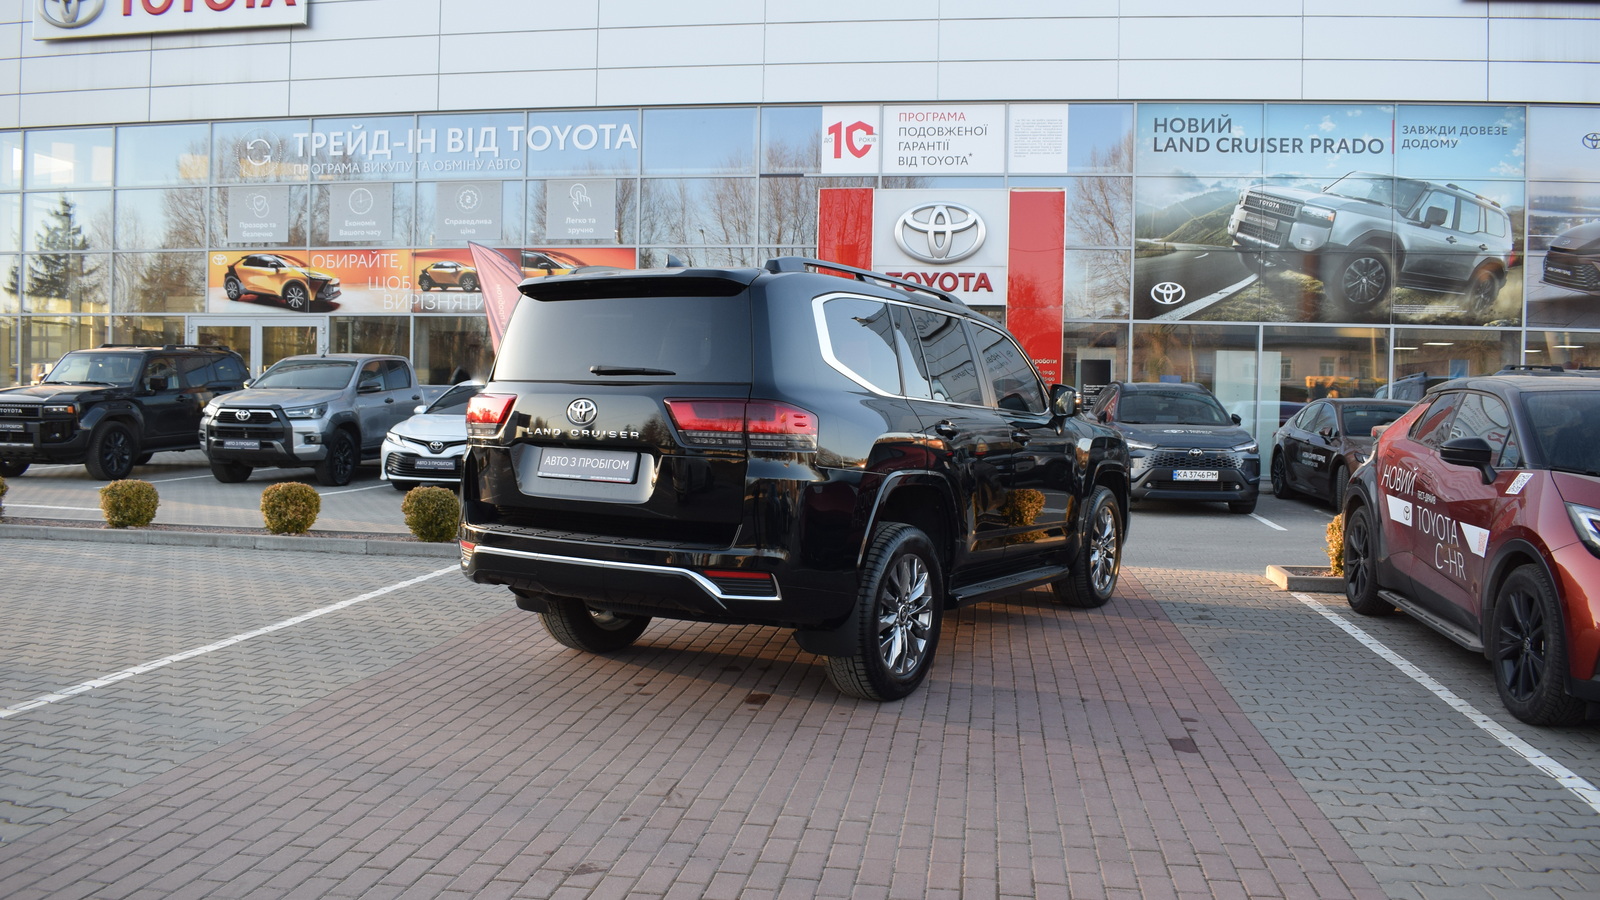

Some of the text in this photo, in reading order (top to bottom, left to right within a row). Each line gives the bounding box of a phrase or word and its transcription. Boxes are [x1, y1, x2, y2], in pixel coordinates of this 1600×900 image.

[898, 112, 966, 122] ПРОГРАМА
[1153, 114, 1232, 134] НОВИЙ
[898, 124, 989, 138] ПОДОВЖЕНОЇ
[1402, 125, 1508, 136] ЗАВЖДИ ДОВЕЗЕ
[293, 123, 638, 161] ТРЕЙД-ІН ВІД TOYOTA
[898, 139, 950, 151] ГАРАНТІЇ
[1153, 137, 1384, 154] LAND CRUISER PRADO
[1401, 139, 1459, 150] ДОДОМУ
[293, 158, 521, 175] ПРОГРАМА ВИКУПУ ТА ОБМІНУ АВТО
[898, 156, 918, 167] ВІД
[1259, 199, 1280, 209] TOYOTA
[239, 221, 268, 230] Прозоро
[344, 219, 376, 227] Економія
[444, 217, 493, 227] Справедлива
[565, 216, 587, 225] Легко
[242, 230, 273, 238] безпечно
[366, 229, 381, 237] часу
[460, 227, 476, 235] ціна
[567, 227, 594, 235] зручно
[368, 275, 411, 292] ЩОБ
[885, 271, 994, 293] TOYOTA
[1034, 357, 1058, 365] роботи
[526, 427, 640, 439] LAND CRUISER
[544, 456, 630, 470] АВТО З ПРОБІГОМ
[1189, 471, 1206, 479] 3746
[1380, 465, 1418, 497] НОВИЙ
[1416, 505, 1460, 548] TOYOTA
[1435, 542, 1467, 581] C-HR
